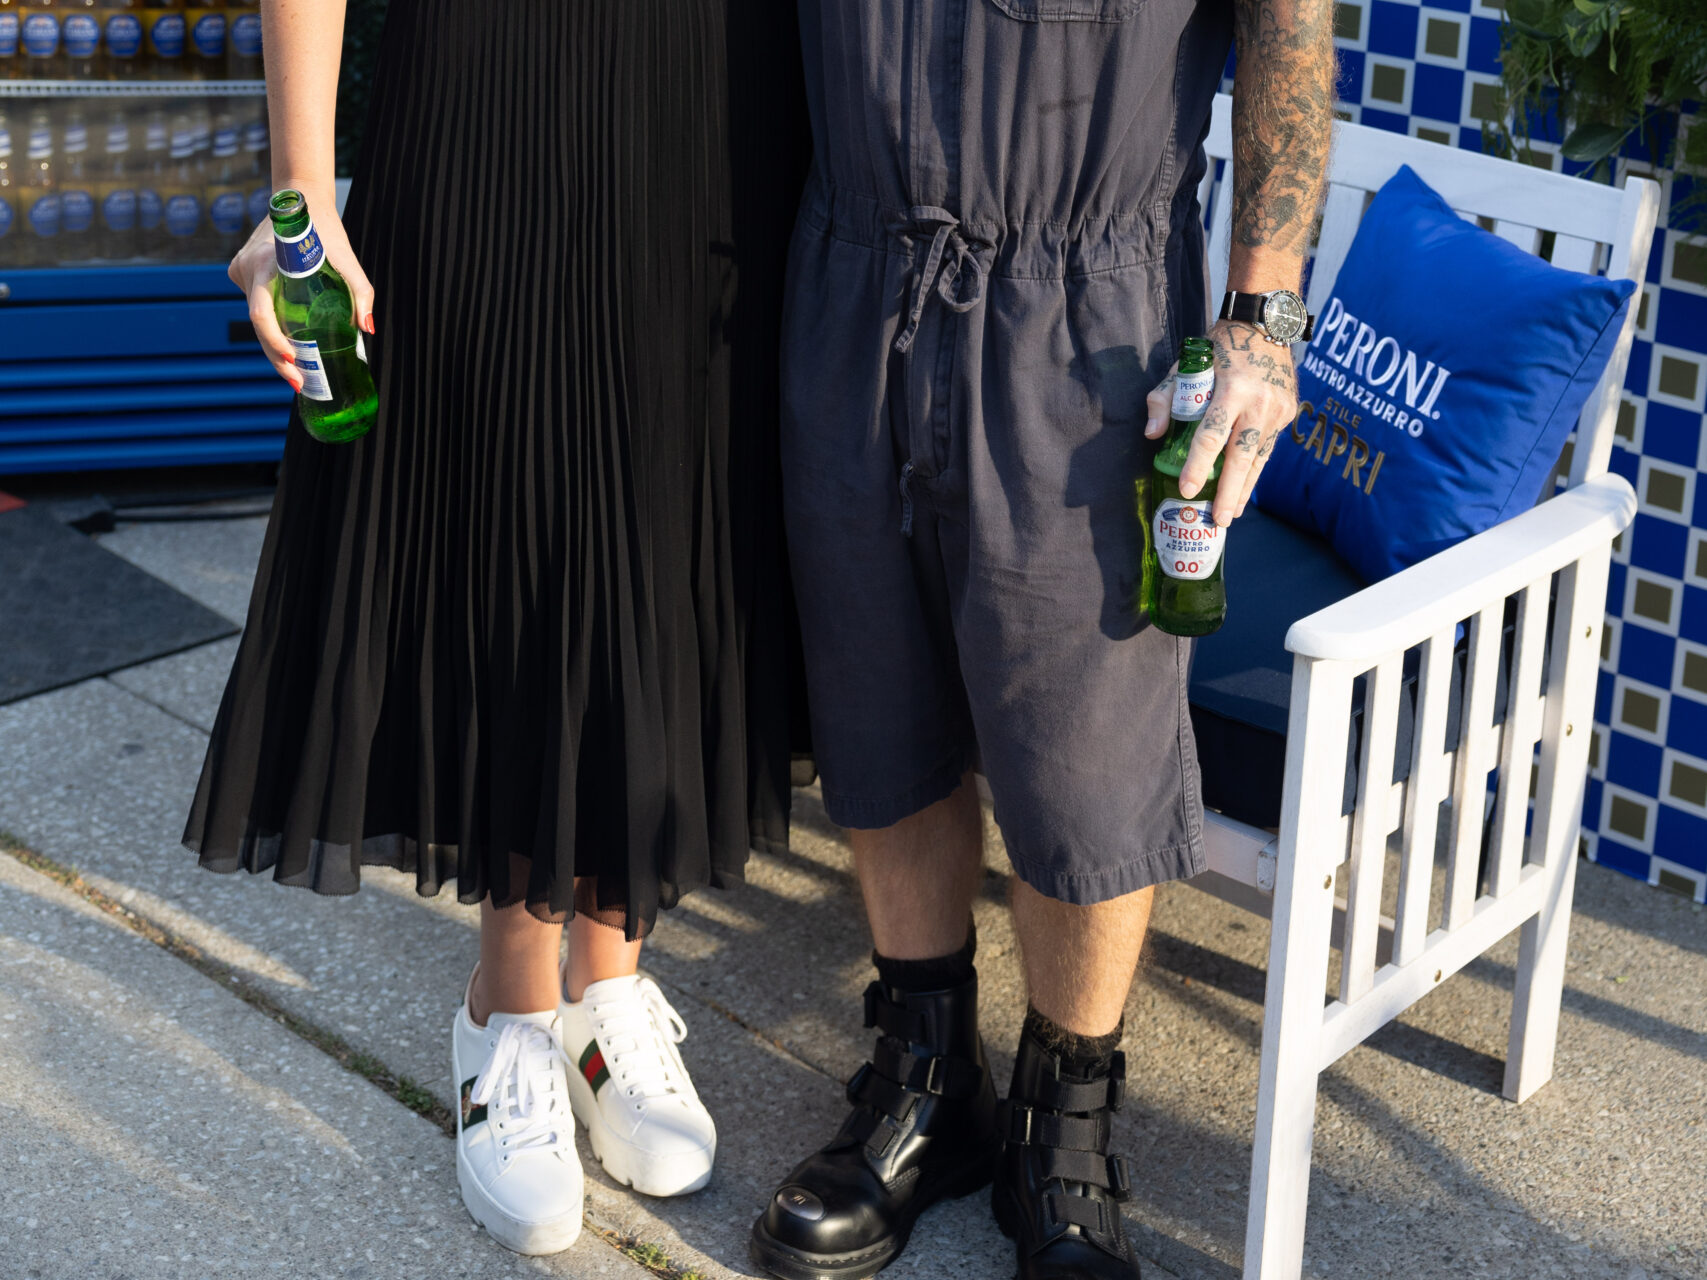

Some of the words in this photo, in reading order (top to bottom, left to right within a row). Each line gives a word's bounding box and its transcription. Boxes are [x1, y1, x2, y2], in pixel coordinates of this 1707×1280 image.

[1303, 352, 1346, 392] NASTRO
[1344, 381, 1424, 439] AZZURRO
[1324, 396, 1361, 429] STILE
[1291, 400, 1385, 496] CAPRI
[1159, 519, 1218, 541] PERONI
[1172, 539, 1204, 547] NASTRO
[1165, 543, 1210, 552] AZZURRO
